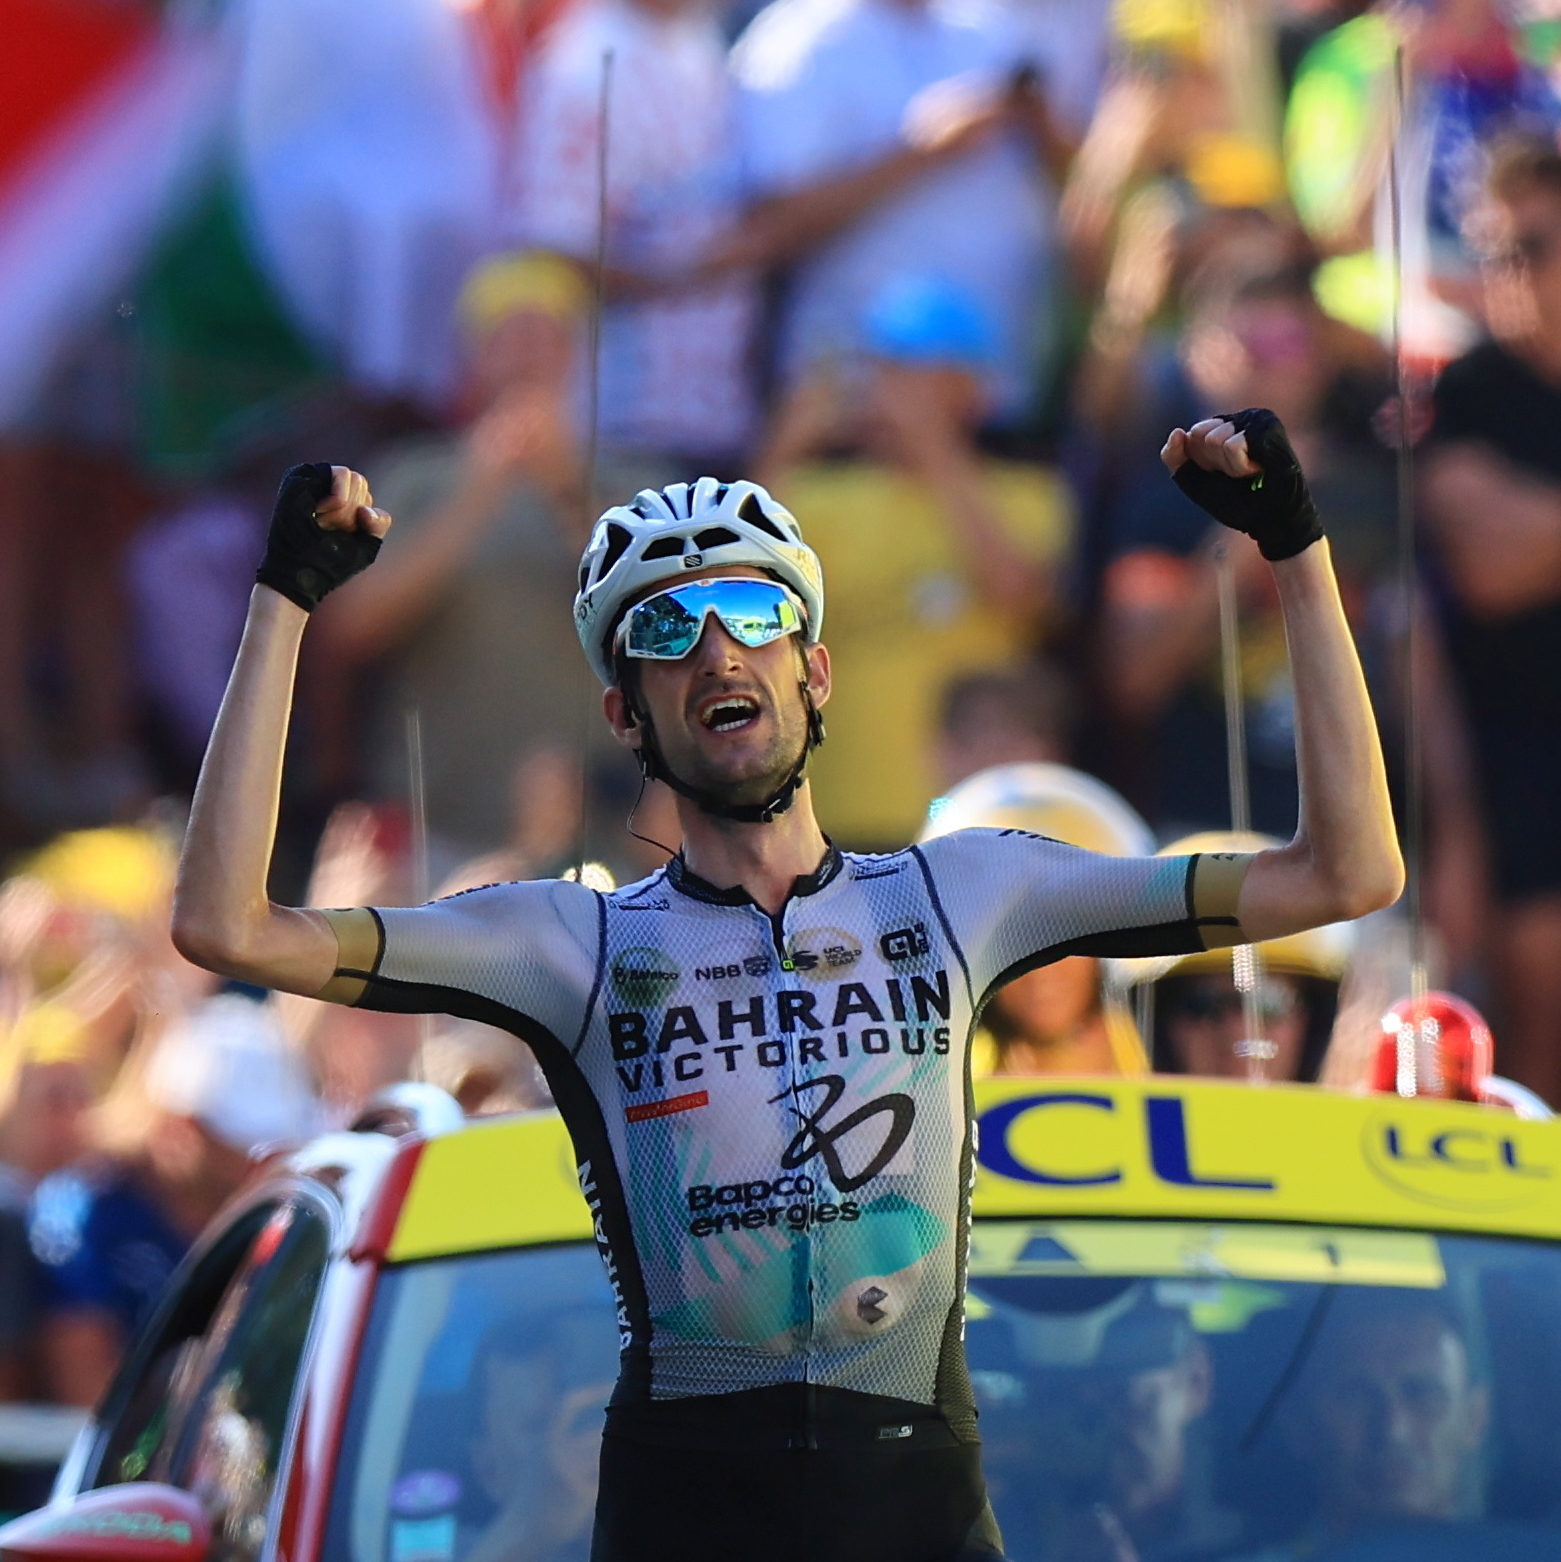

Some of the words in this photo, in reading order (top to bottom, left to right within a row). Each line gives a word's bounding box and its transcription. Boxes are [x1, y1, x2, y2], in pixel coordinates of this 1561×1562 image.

[695, 964, 741, 981] NBB
[608, 969, 951, 1060] BAHRAIN
[616, 1027, 951, 1092] VICTORIOUS
[975, 1092, 1277, 1187] CL
[1383, 1124, 1551, 1177] LCL
[689, 1174, 815, 1211] Bapco
[689, 1201, 860, 1237] energies
